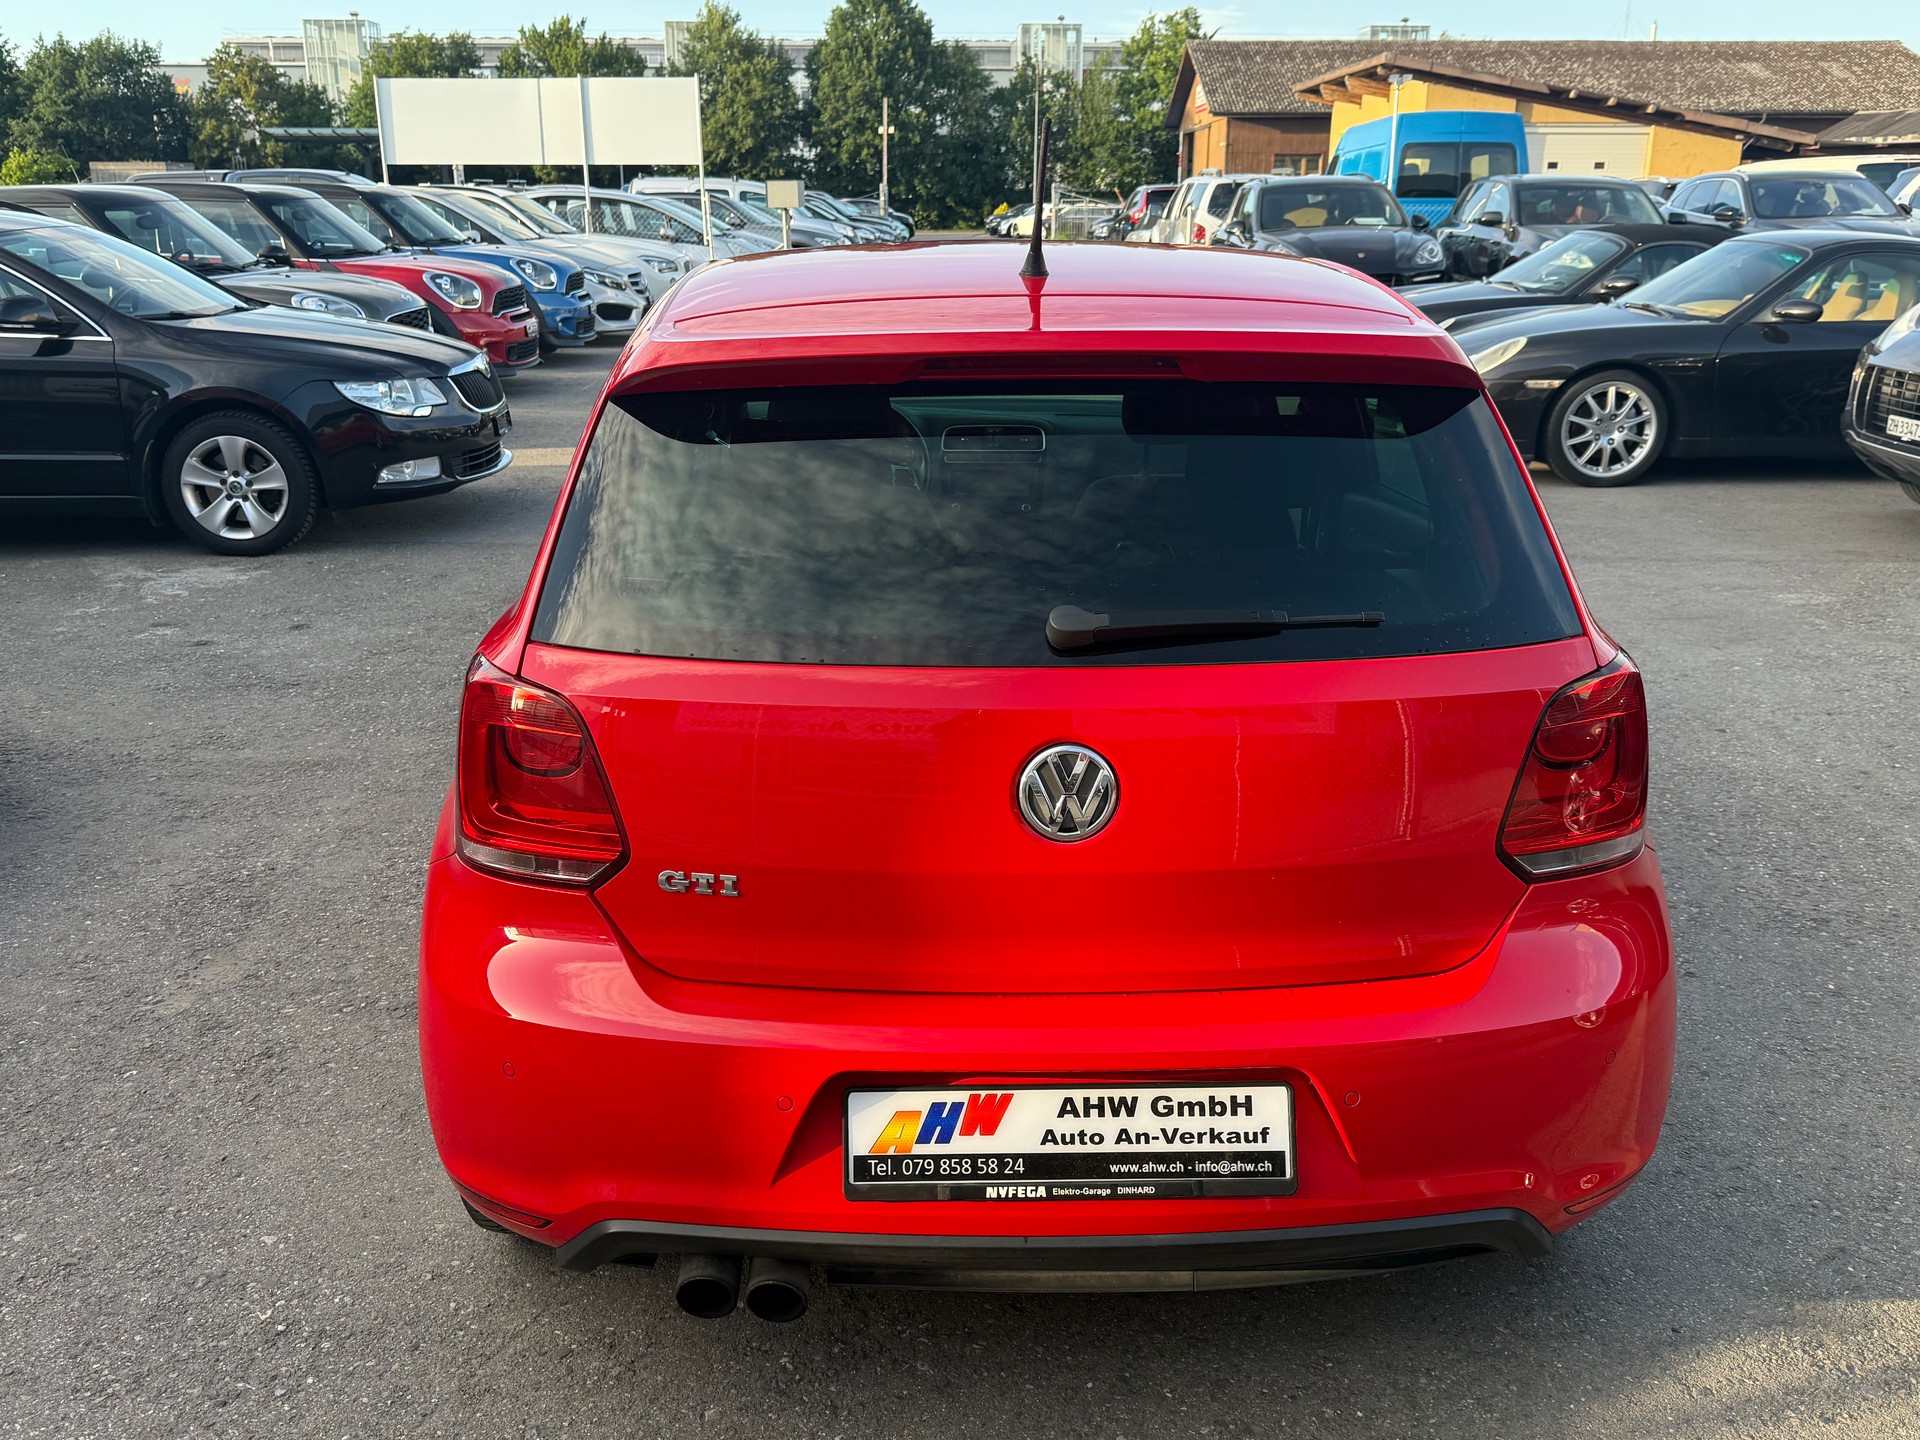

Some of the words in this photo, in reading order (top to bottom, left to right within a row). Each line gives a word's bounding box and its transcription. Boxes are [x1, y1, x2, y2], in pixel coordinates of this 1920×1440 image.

[1019, 745, 1117, 841] VW
[657, 869, 739, 897] GTI
[1056, 1096, 1139, 1119] AHW
[1150, 1095, 1253, 1117] GmbH
[868, 1093, 1014, 1153] AHW
[1039, 1128, 1105, 1146] Auto
[1114, 1126, 1271, 1146] An-Verkauf
[867, 1159, 897, 1176] Tel.
[902, 1159, 935, 1175] 079
[939, 1158, 972, 1175] 858
[977, 1158, 999, 1174] 58
[1003, 1157, 1025, 1174] 24
[1109, 1160, 1184, 1173] www.ahw.ch
[1195, 1160, 1273, 1175] info@ahw.ch
[985, 1186, 1047, 1198] NYFEGA
[1052, 1187, 1112, 1196] Elektro-Garage
[1117, 1186, 1156, 1195] DINHARD
